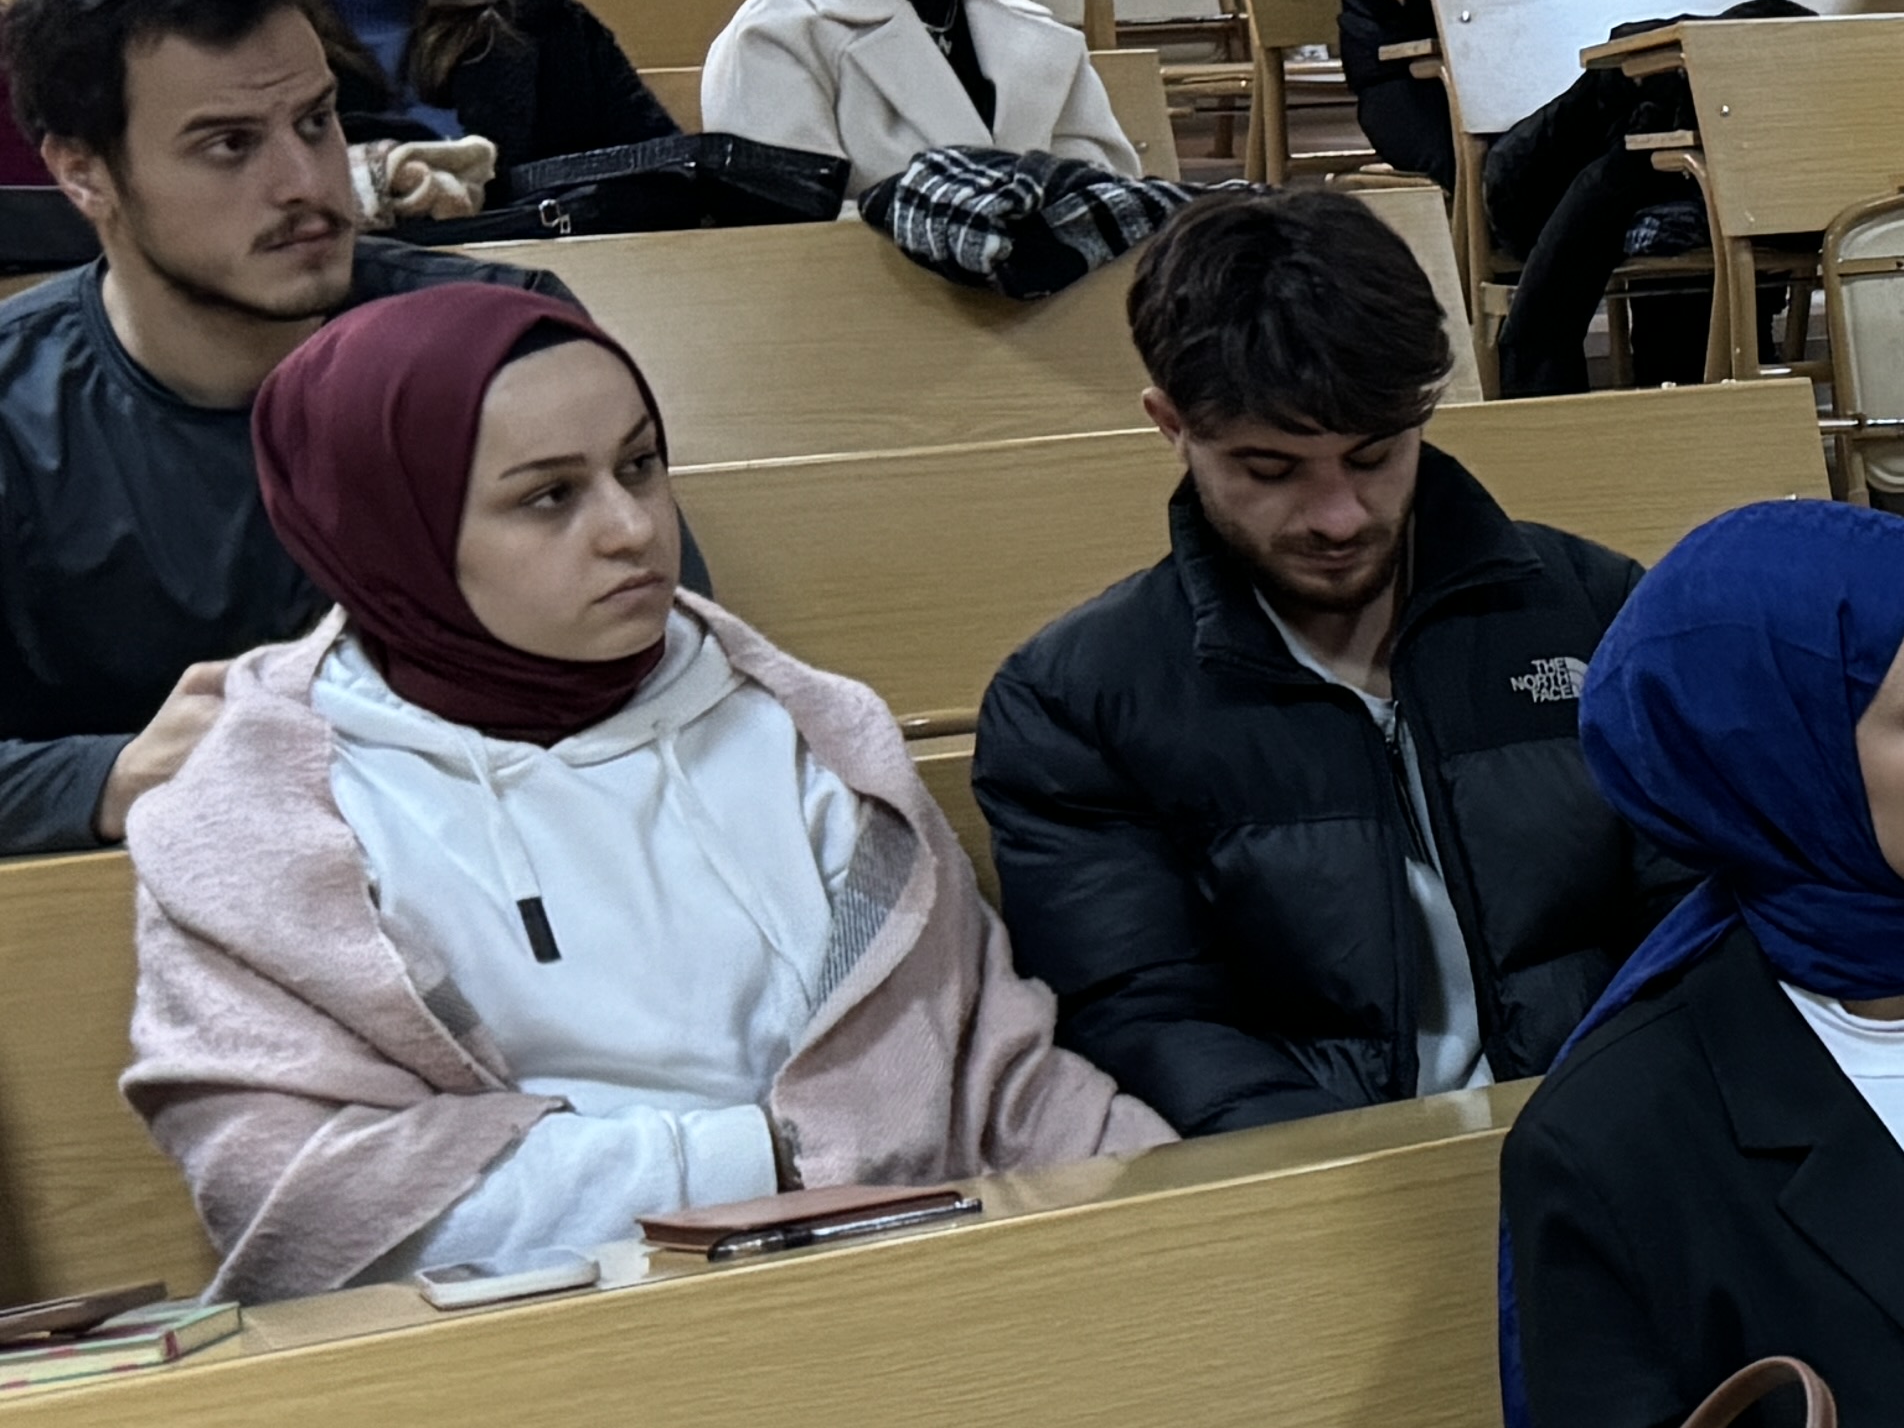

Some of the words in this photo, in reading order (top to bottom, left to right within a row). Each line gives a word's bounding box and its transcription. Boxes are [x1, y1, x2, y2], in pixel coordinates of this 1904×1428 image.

[1530, 657, 1567, 675] THE
[1510, 667, 1571, 692] NORTH
[1531, 684, 1575, 703] FACE
